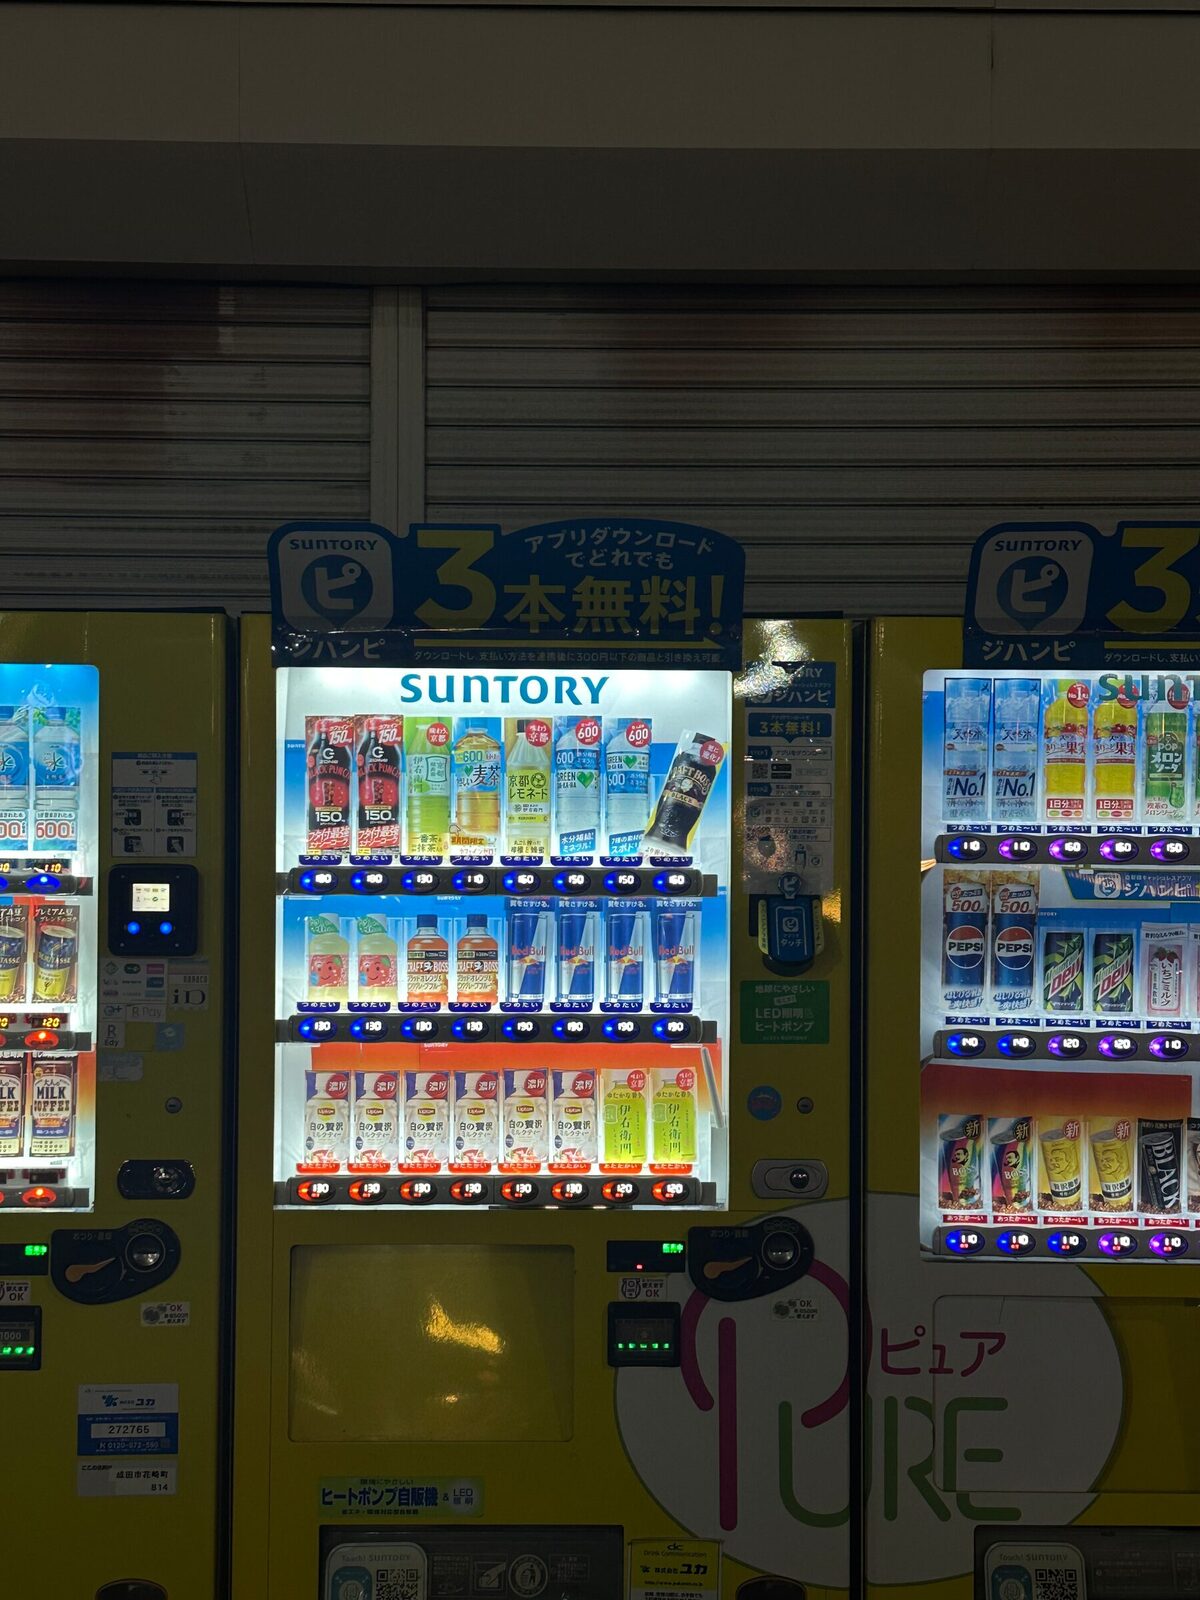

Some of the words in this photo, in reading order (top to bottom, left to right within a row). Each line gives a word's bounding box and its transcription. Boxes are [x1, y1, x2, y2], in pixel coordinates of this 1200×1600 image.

[289, 538, 378, 552] SUNTORY
[524, 526, 715, 555] アプリダウンロード
[994, 539, 1083, 552] SUNTORY
[565, 549, 674, 571] でどれでも
[314, 561, 362, 610] ピ
[1010, 563, 1061, 613] ピ
[288, 637, 386, 659] ジハンピ
[981, 640, 1077, 662] ジハンピ
[400, 673, 610, 706] SUNTORY
[577, 726, 598, 740] 600
[759, 720, 821, 735] 3本無料!
[628, 729, 649, 742] 600
[1158, 742, 1178, 751] POP
[463, 751, 483, 763] 600
[556, 752, 574, 764] 600
[1151, 752, 1183, 763] メロン
[1154, 763, 1180, 773] ソーダ
[473, 765, 501, 786] 麦茶
[509, 774, 529, 787] 京都
[953, 773, 986, 796] No.1
[1003, 773, 1035, 796] No.1
[509, 788, 548, 800] レモネード
[36, 821, 71, 839] 600
[44, 863, 62, 873] 110
[1124, 882, 1192, 898] ジハンピ
[952, 900, 981, 912] 500
[1000, 901, 1029, 913] 500
[529, 945, 546, 956] Bull
[577, 945, 594, 956] Bull
[627, 945, 643, 956] Bull
[677, 944, 694, 955] Bull
[948, 942, 983, 952] PEPSI
[997, 943, 1032, 953] PEPSI
[755, 984, 816, 994] 地球にやさしい
[1160, 961, 1172, 1007] いちごミルク
[42, 1017, 60, 1028] 120
[314, 1020, 331, 1032] 130
[365, 1020, 382, 1032] 130
[415, 1020, 433, 1032] 130
[466, 1021, 483, 1032] 130
[755, 1021, 815, 1033] ヒートポンプ
[1062, 1038, 1080, 1049] 120
[1113, 1038, 1131, 1050] 120
[1165, 1039, 1182, 1050] 110
[37, 1086, 66, 1099] MILK
[34, 1100, 70, 1112] COFFEE
[619, 1105, 631, 1154] 伊右衛門
[668, 1104, 680, 1153] 伊右衛門
[966, 1120, 980, 1138] 新
[1016, 1123, 1029, 1139] 新
[1065, 1122, 1080, 1138] 新
[1116, 1122, 1130, 1138] 新
[1151, 1142, 1180, 1209] BLACK
[312, 1182, 330, 1194] 130
[363, 1182, 381, 1194] 130
[414, 1182, 431, 1194] 130
[465, 1182, 482, 1194] 130
[515, 1183, 532, 1194] 130
[565, 1182, 583, 1194] 130
[960, 1234, 978, 1245] 110
[1010, 1234, 1029, 1246] 110
[1061, 1235, 1079, 1246] 110
[1112, 1235, 1131, 1247] 110
[1164, 1236, 1182, 1247] 110
[9, 1292, 24, 1301] OK
[645, 1289, 660, 1298] OK
[169, 1304, 182, 1312] OK
[800, 1299, 812, 1308] OK
[881, 1325, 1006, 1376] ピュア
[108, 1425, 150, 1434] 272765
[116, 1470, 169, 1479] 成田市花崎町
[322, 1487, 439, 1507] ヒートポンプ自販機
[453, 1488, 474, 1497] LED
